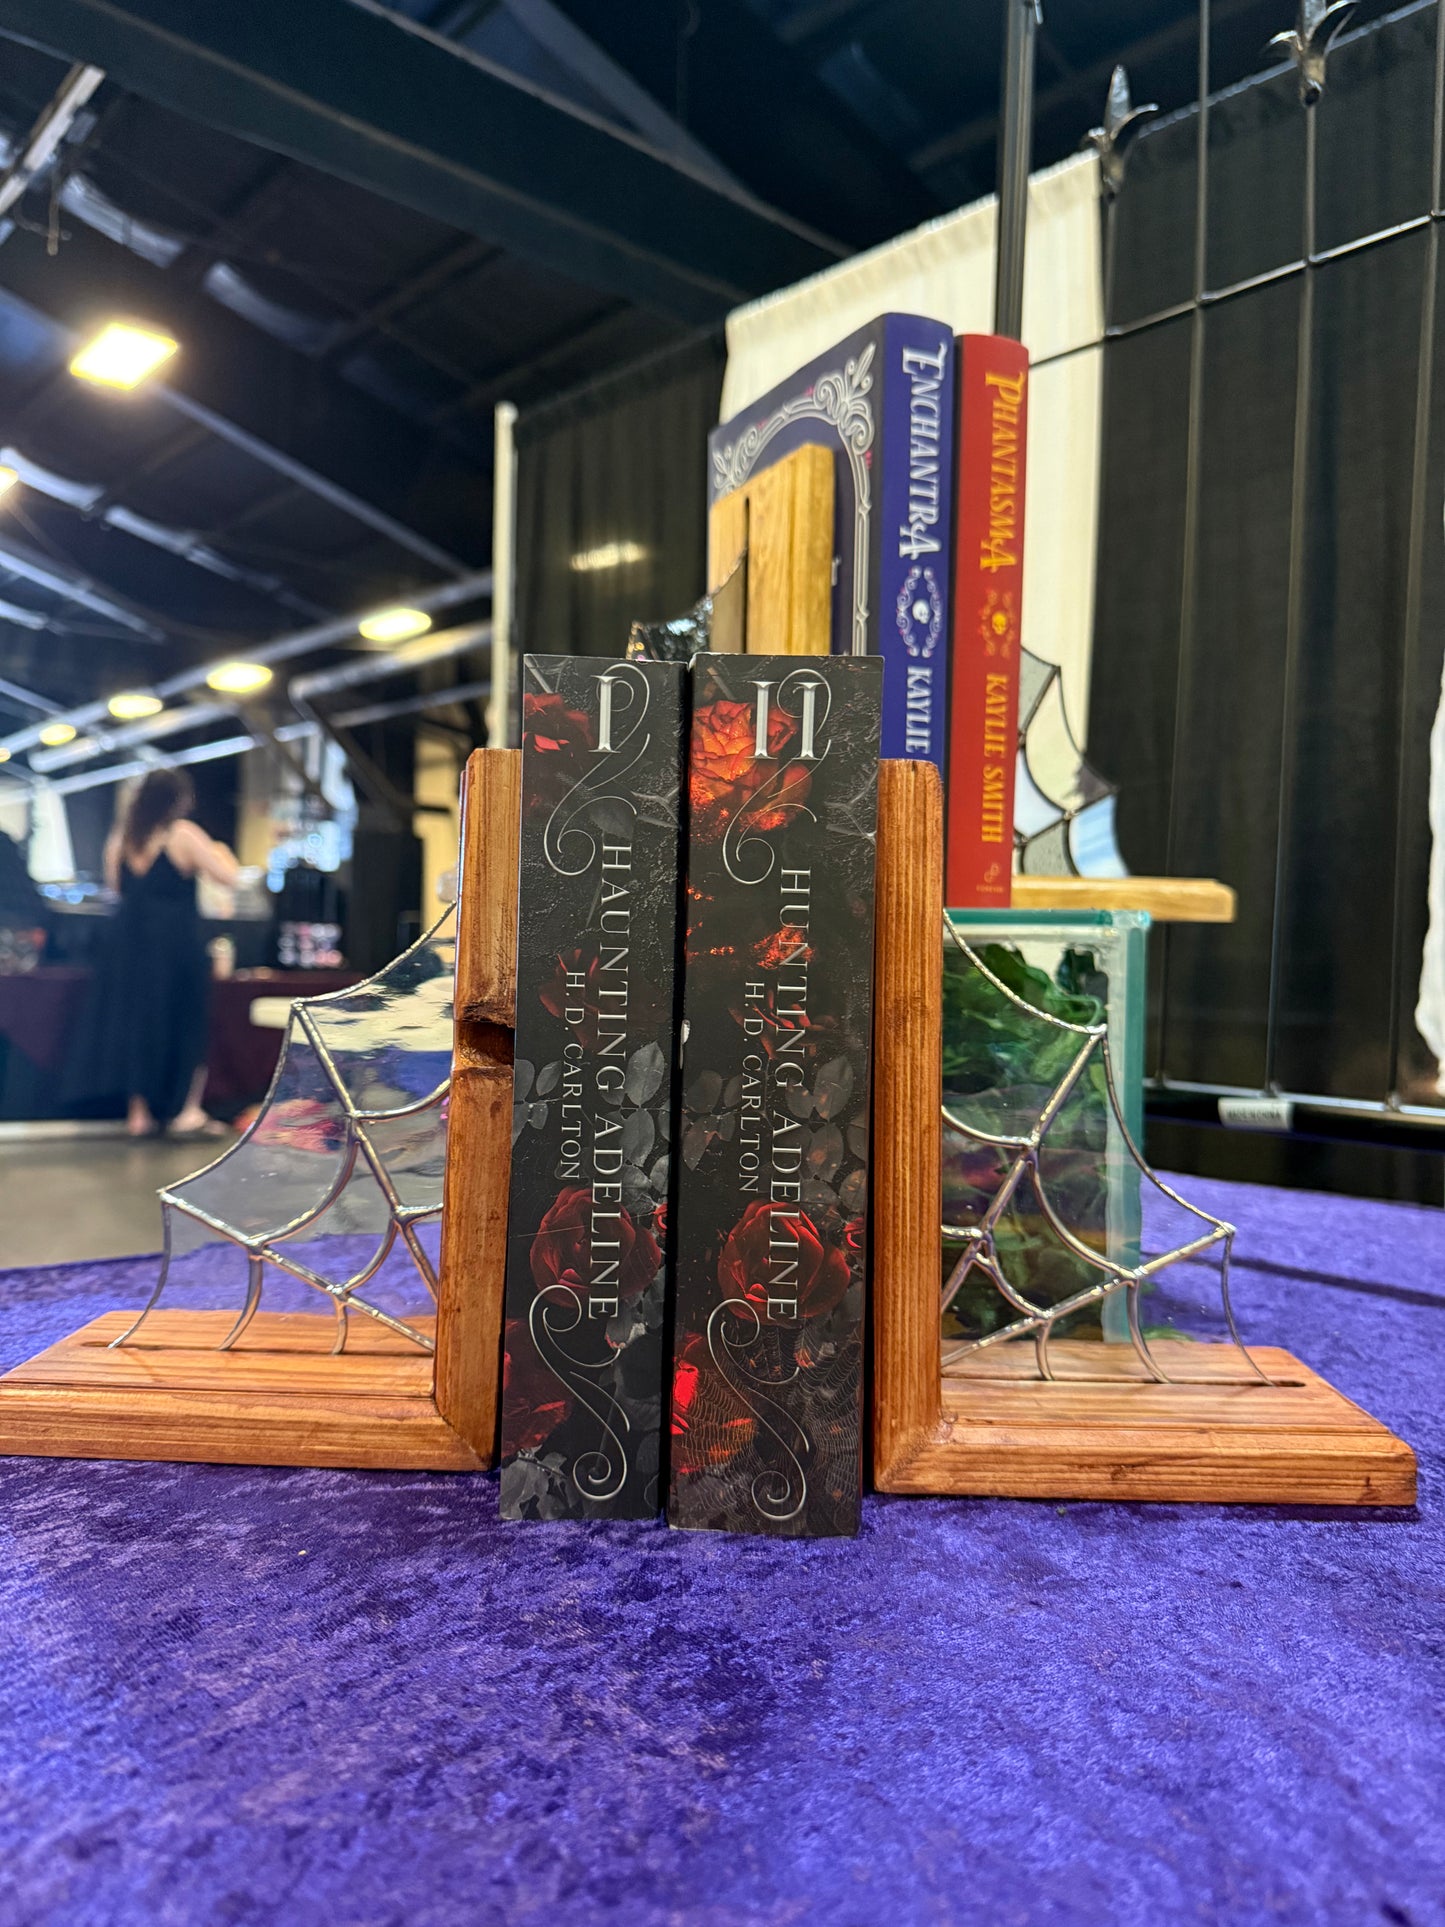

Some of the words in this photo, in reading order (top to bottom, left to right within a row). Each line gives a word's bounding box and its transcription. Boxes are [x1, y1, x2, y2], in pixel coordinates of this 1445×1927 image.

[899, 342, 947, 560] ENCHANTRA
[979, 371, 1024, 573] PHANTASMA
[905, 665, 933, 754] KAYLIE
[984, 672, 1008, 757] KAYLIE
[981, 766, 1006, 843] SMITH
[564, 1007, 585, 1031] D.
[565, 971, 585, 996] H.
[595, 843, 632, 1092] HAUNTING
[743, 1018, 763, 1042] D.
[745, 982, 765, 1007] H.
[774, 868, 811, 1088] HUNTING
[560, 1043, 584, 1180] CARLTON
[739, 1055, 763, 1193] CARLTON
[588, 1114, 623, 1319] ADELINE
[766, 1110, 803, 1320] ADELINE
